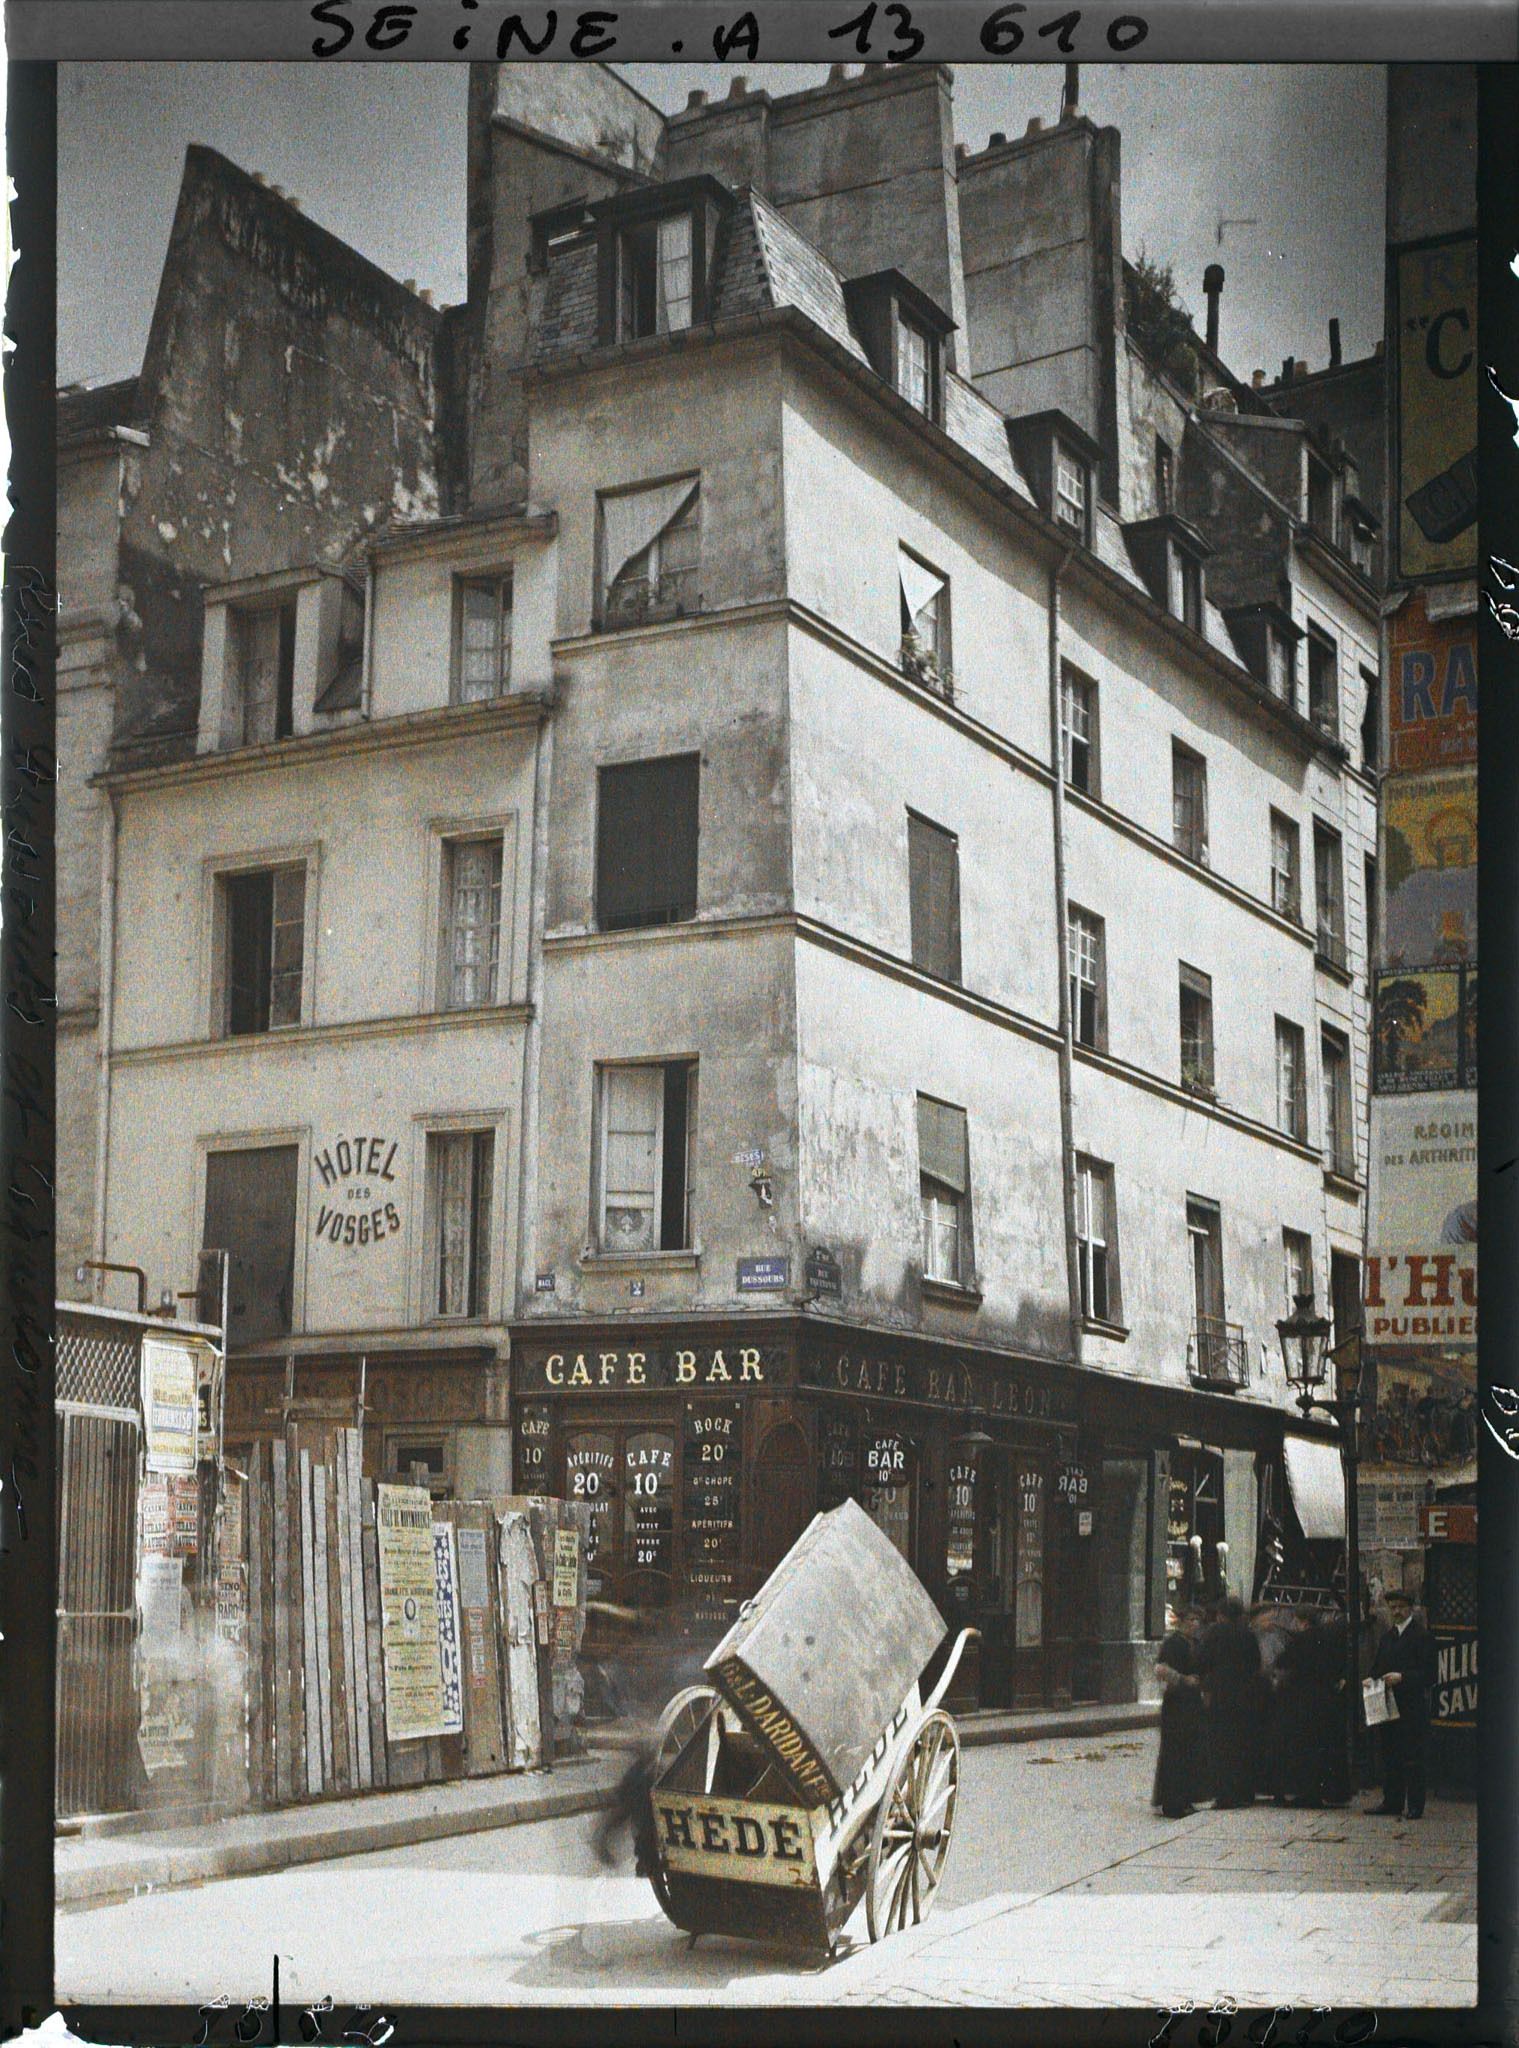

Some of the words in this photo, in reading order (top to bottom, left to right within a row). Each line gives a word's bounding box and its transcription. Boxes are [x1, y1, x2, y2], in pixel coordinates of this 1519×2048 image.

[347, 1187, 371, 1199] DES
[315, 1202, 400, 1245] VOSGES
[545, 1353, 647, 1386] CAFE
[675, 1348, 764, 1382] BAR
[694, 1417, 733, 1435] BOCK
[875, 1439, 900, 1452] CAFE
[626, 1449, 672, 1467] CAFE
[868, 1450, 905, 1469] BAR
[950, 1465, 976, 1483] CAFE
